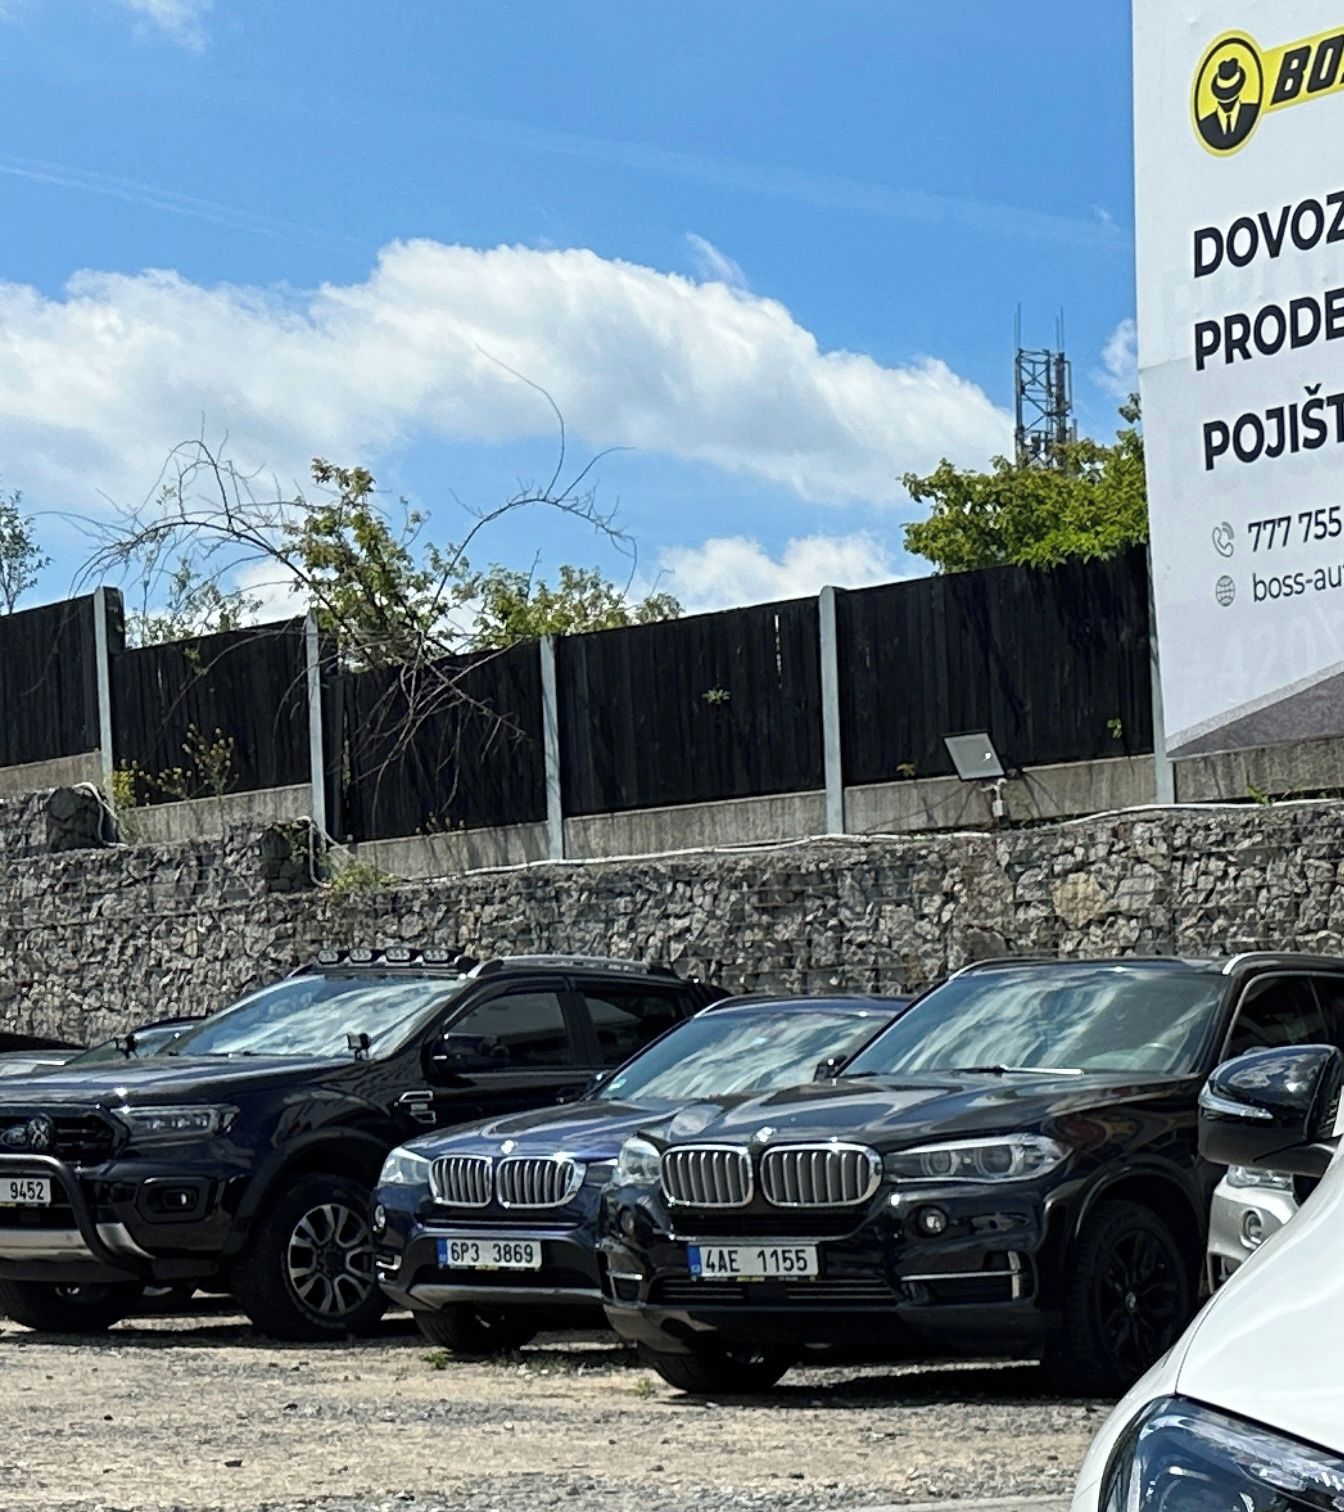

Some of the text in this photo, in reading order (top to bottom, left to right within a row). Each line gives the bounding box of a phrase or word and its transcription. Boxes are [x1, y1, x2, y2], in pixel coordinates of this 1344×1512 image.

[1248, 515, 1292, 553] 777
[1298, 505, 1343, 544] 755
[10, 1181, 45, 1201] 9452
[451, 1242, 480, 1262] 6P3
[492, 1243, 534, 1264] 3869
[705, 1249, 741, 1273] 4AE
[757, 1249, 808, 1273] 1155
